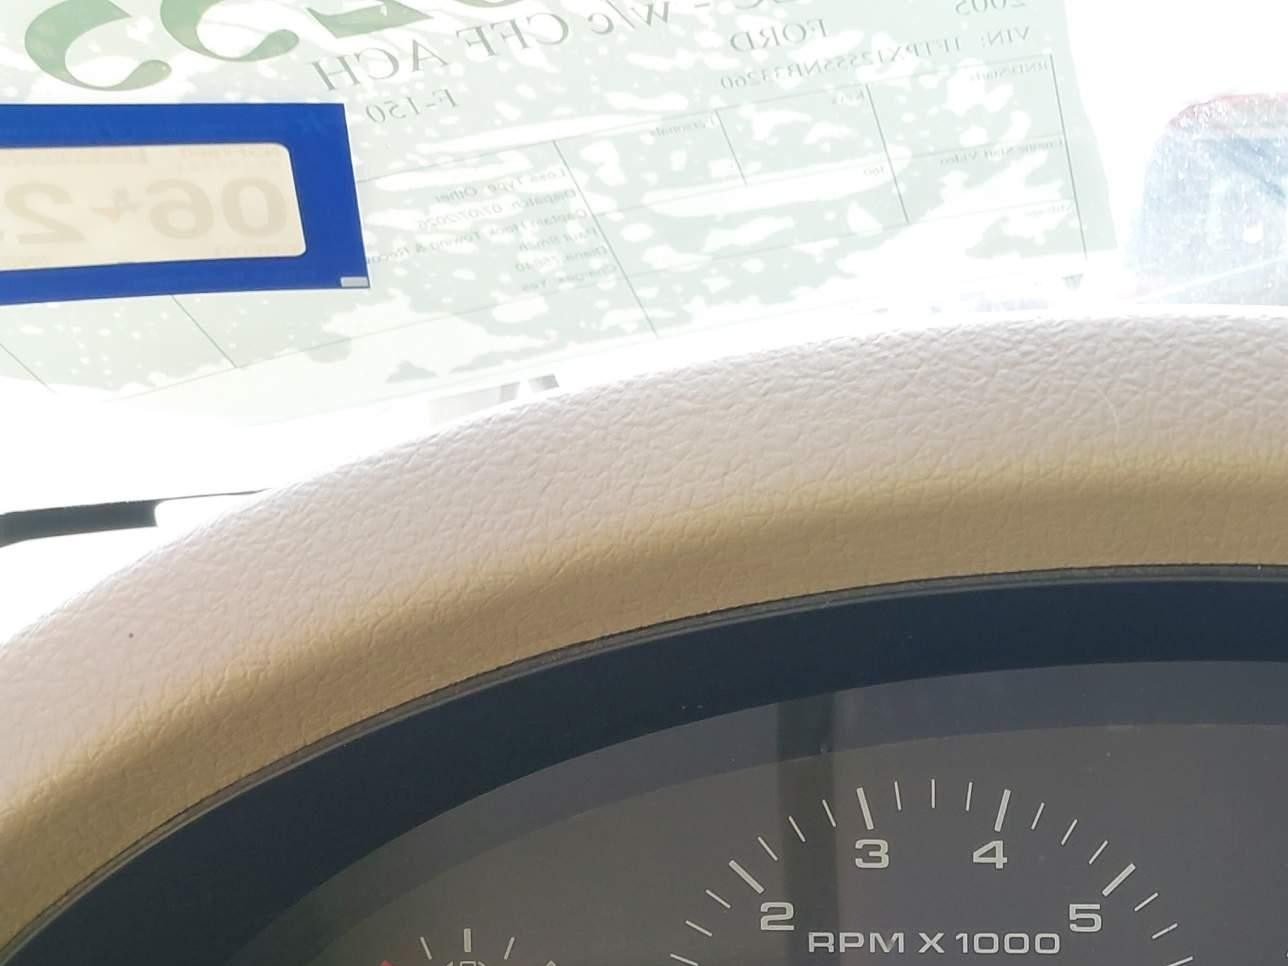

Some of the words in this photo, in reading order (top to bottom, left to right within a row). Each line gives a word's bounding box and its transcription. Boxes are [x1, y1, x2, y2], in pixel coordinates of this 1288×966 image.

[854, 839, 890, 869] 3
[972, 840, 1008, 869] 4
[760, 900, 796, 932] 2
[1068, 903, 1102, 933] 5
[808, 932, 905, 954] RPM
[917, 933, 945, 954] X
[954, 932, 1061, 955] 1000
